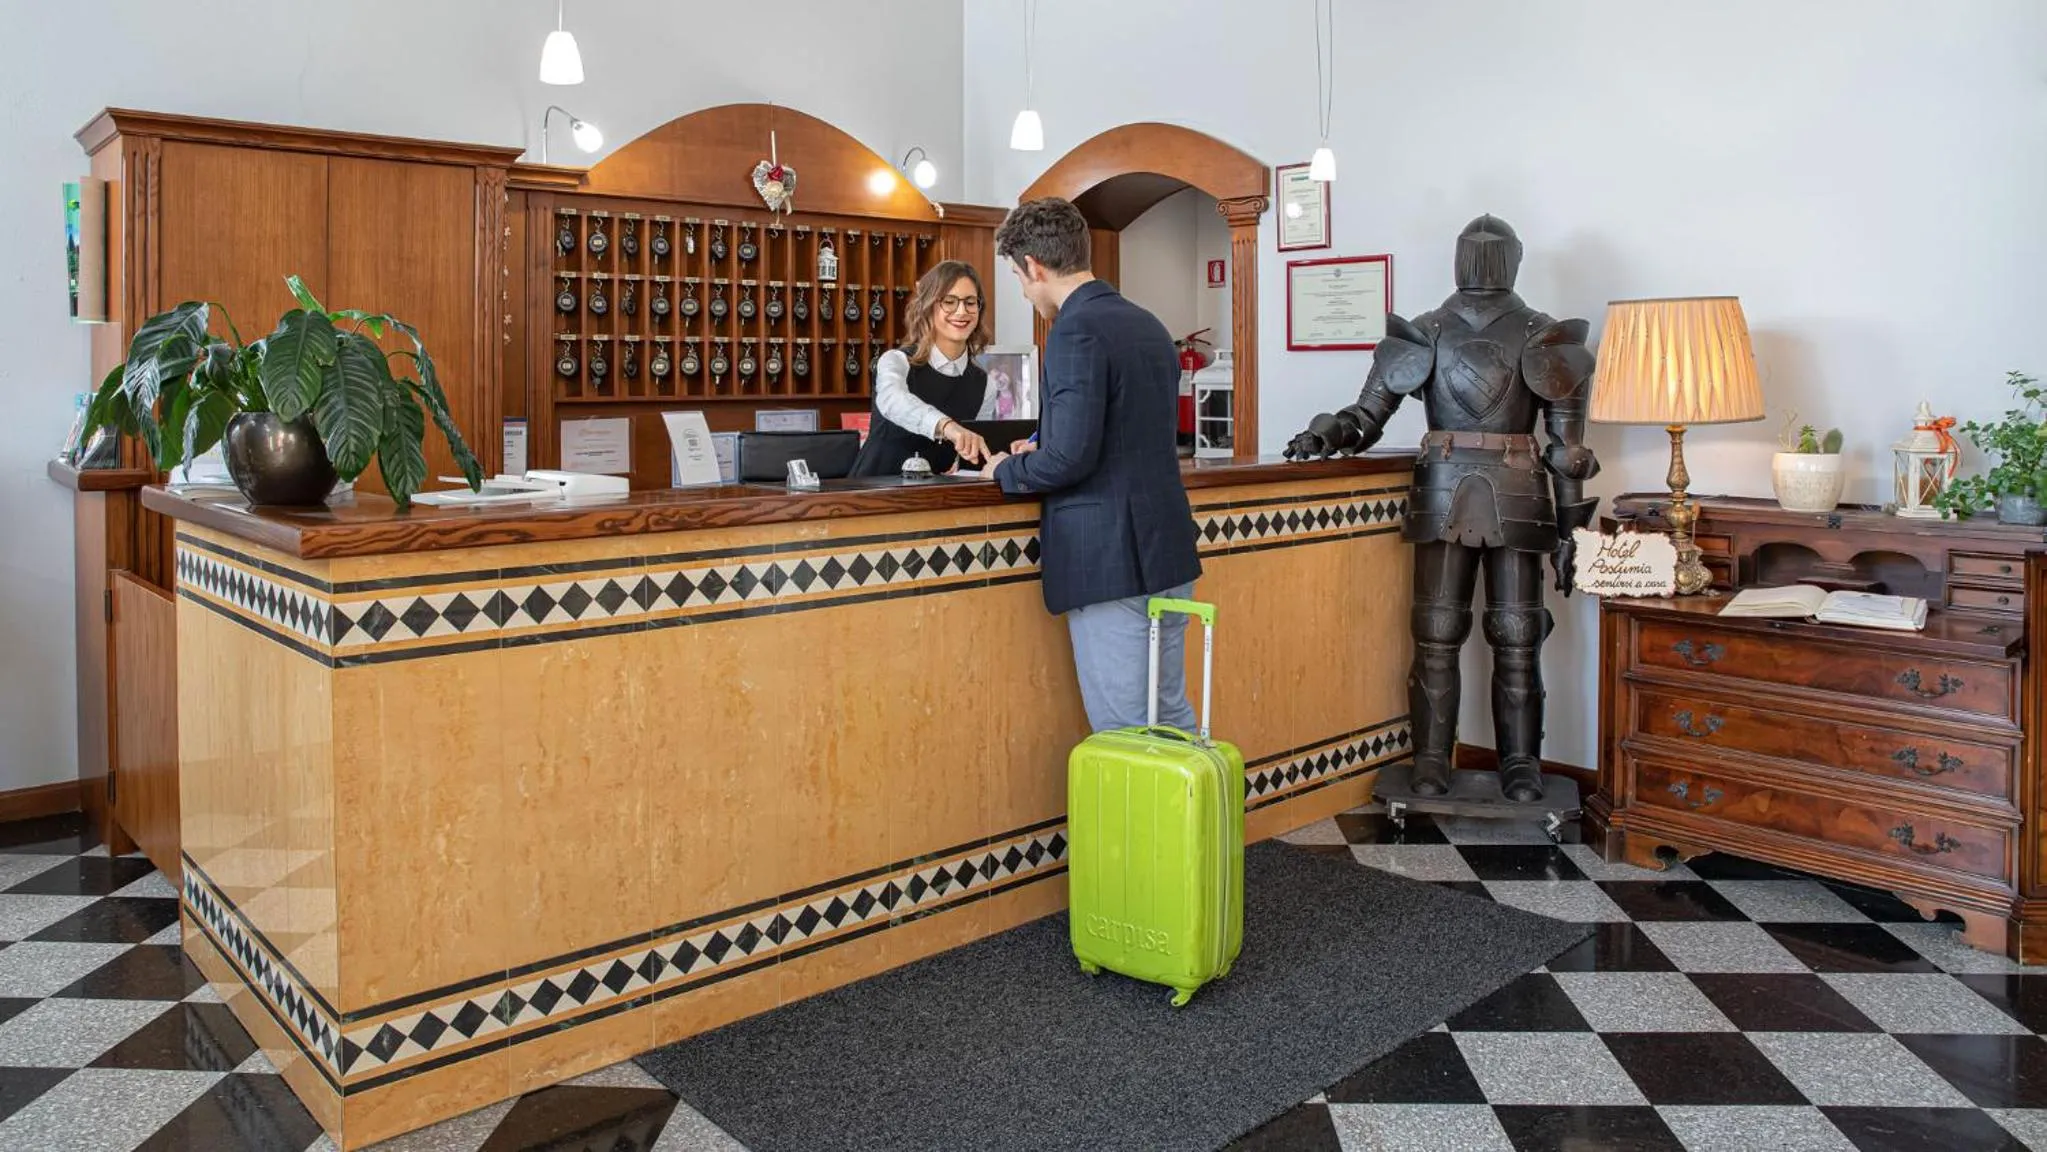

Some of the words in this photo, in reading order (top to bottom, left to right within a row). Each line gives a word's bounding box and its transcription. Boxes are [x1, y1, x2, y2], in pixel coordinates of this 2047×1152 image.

[1597, 538, 1641, 558] Hotel
[1588, 558, 1652, 574] Postumia
[1086, 913, 1173, 956] carpisa
